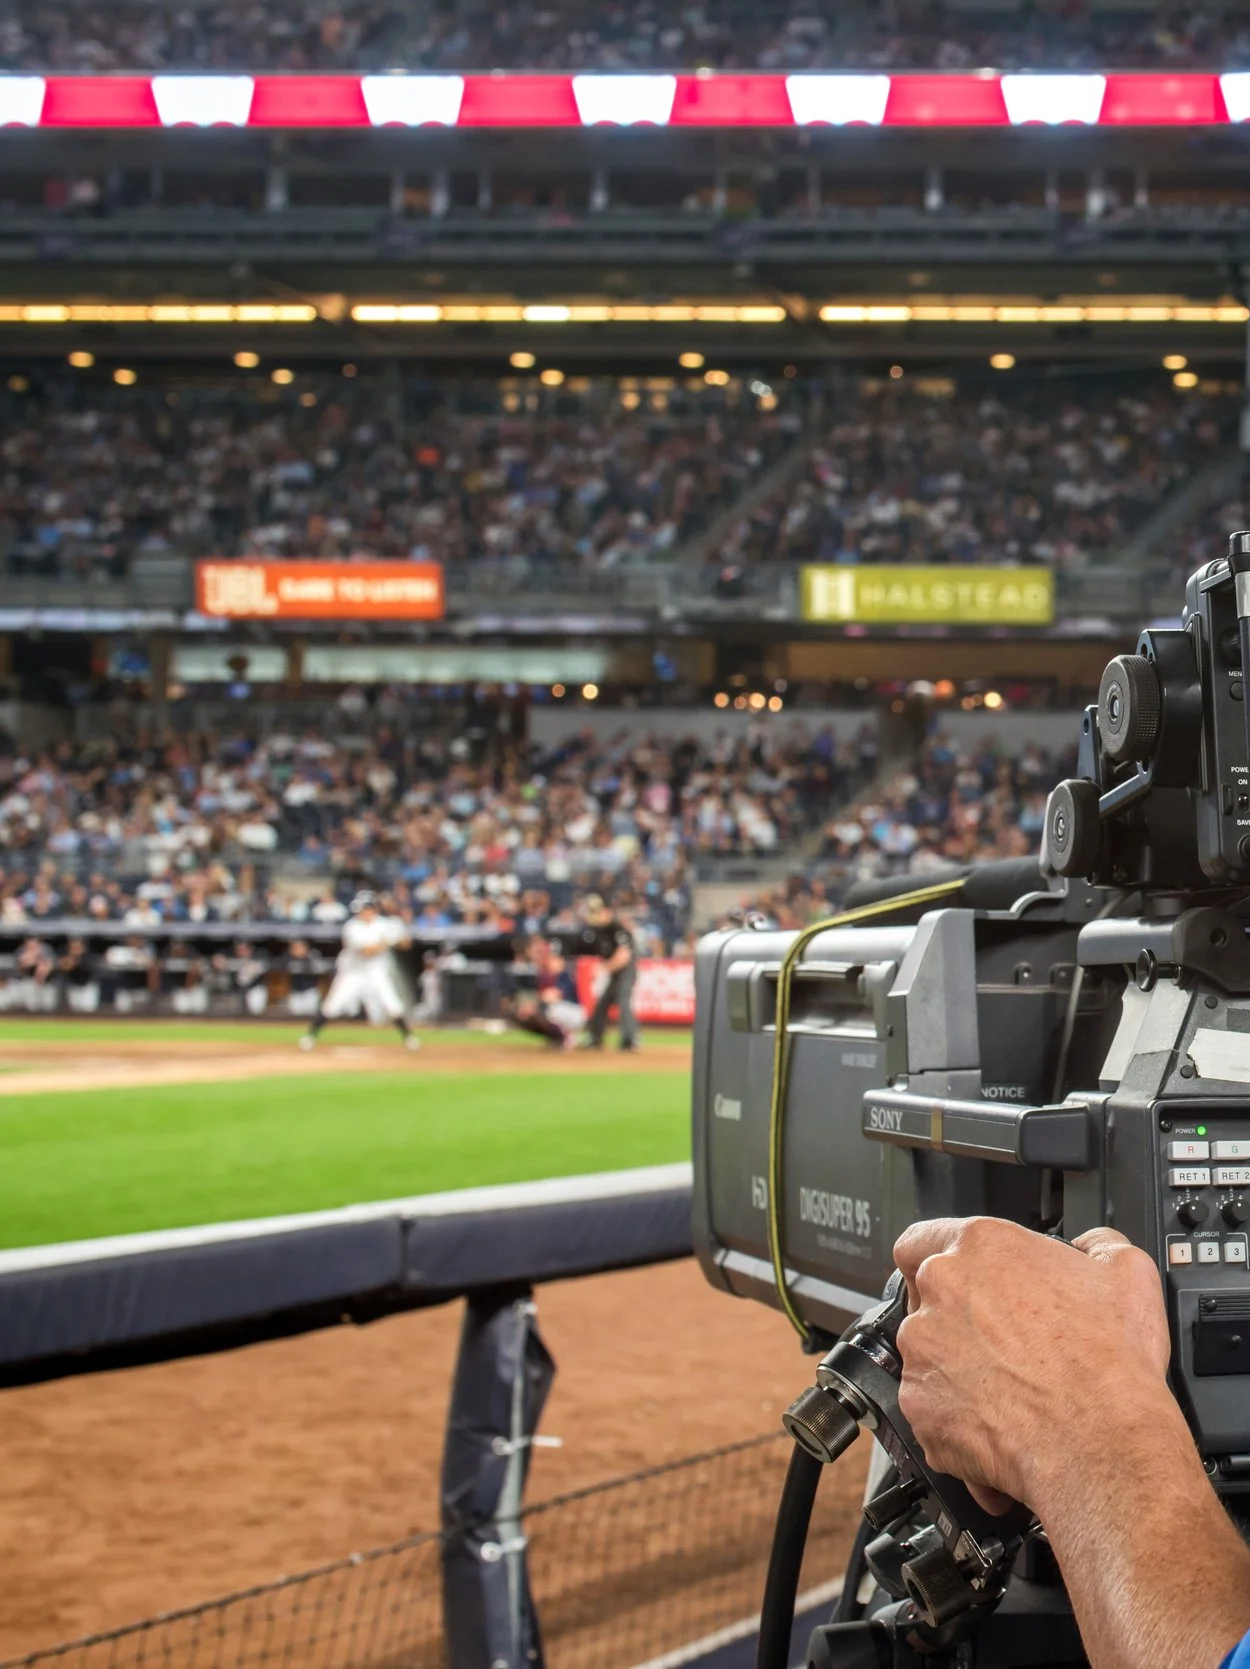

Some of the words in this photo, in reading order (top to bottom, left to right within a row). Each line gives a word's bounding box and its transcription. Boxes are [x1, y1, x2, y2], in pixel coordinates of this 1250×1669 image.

[860, 583, 1049, 610] HALSTEAD
[870, 1107, 903, 1131] SONY
[1187, 1145, 1194, 1153] R
[1231, 1145, 1238, 1153] G
[1179, 1172, 1197, 1180] RET
[1221, 1172, 1239, 1180] RET
[799, 1186, 855, 1233] DIGISUPER
[855, 1199, 871, 1238] 95
